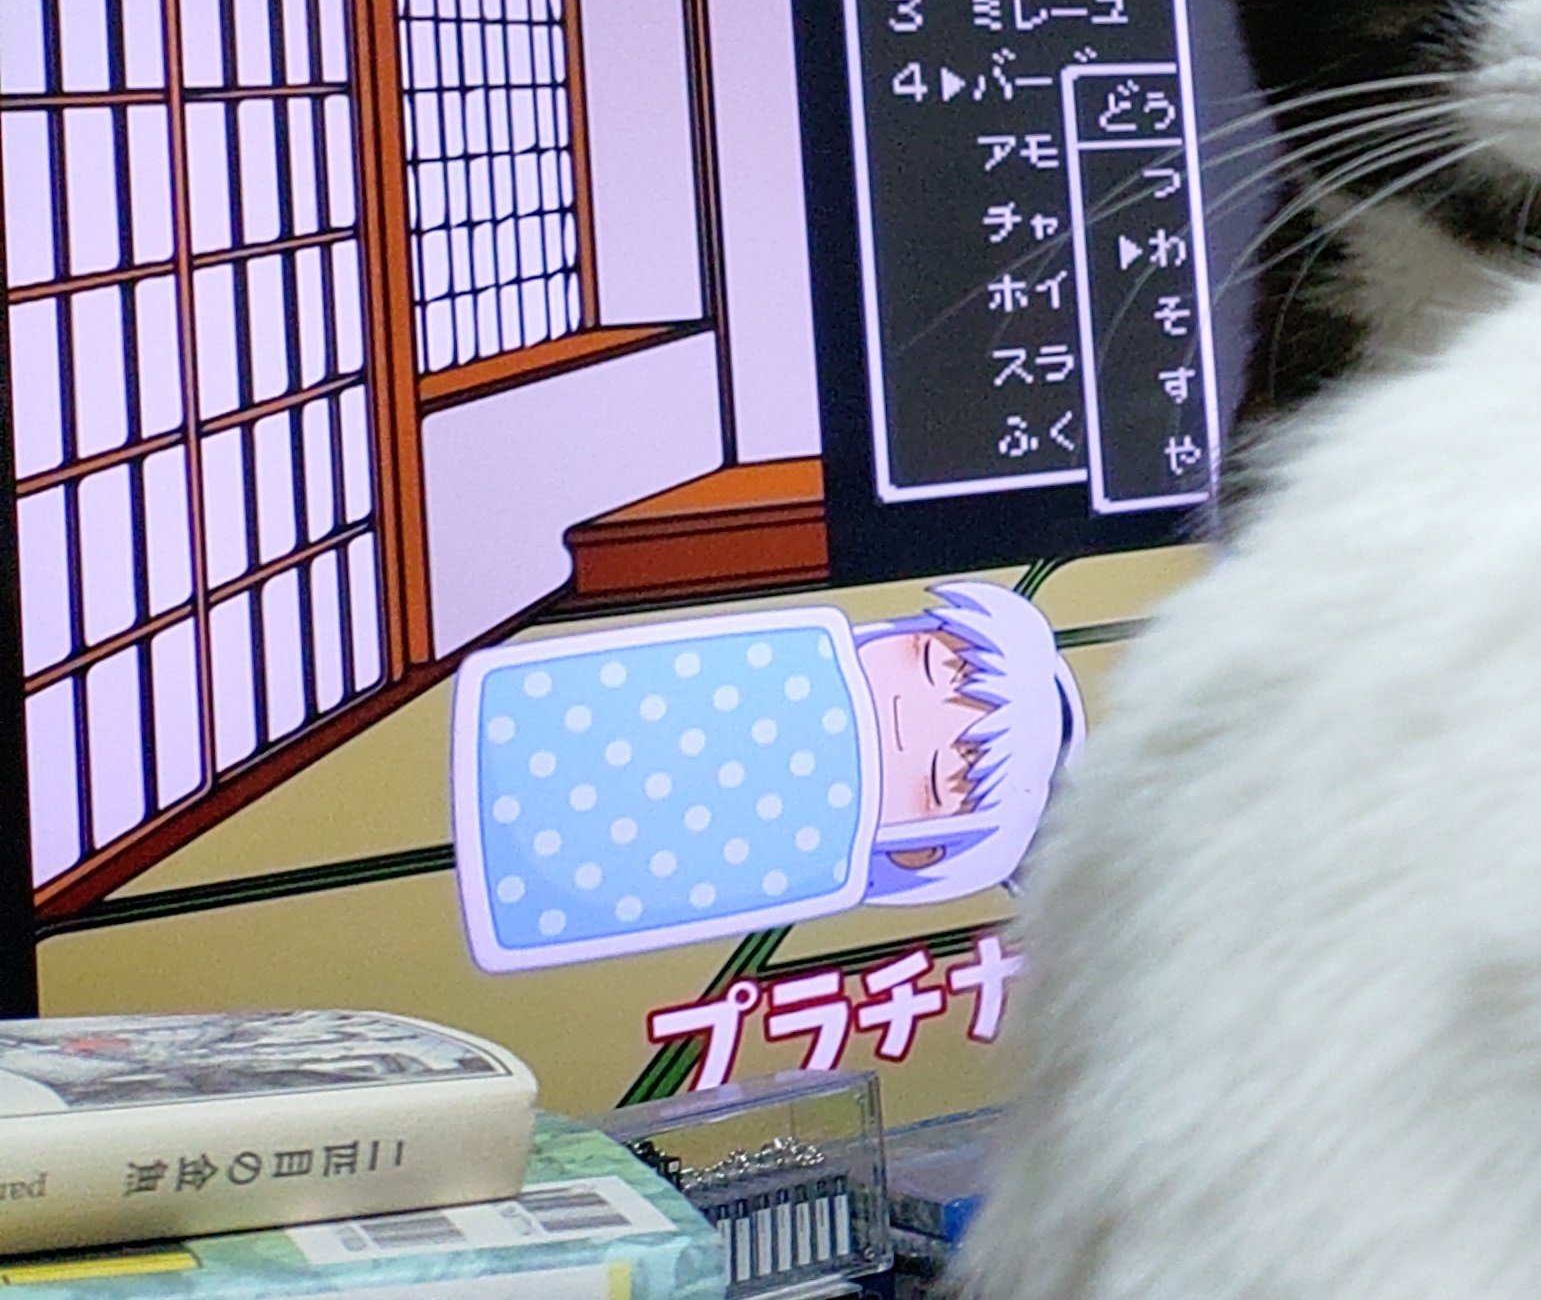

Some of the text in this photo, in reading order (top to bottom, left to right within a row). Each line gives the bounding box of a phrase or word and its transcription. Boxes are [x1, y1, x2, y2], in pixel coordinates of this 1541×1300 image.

[892, 47, 1097, 102] 4 バー
[1099, 79, 1176, 132] どう
[977, 134, 1060, 171] アモ
[1141, 168, 1181, 198] つ
[983, 202, 1059, 243] チャ
[1148, 228, 1187, 269] わ
[988, 271, 1069, 313] ホイ
[1154, 296, 1191, 336] そ
[993, 345, 1075, 386] スラ
[1158, 366, 1196, 405] す
[999, 411, 1075, 456] ふく
[1164, 435, 1202, 475] や
[124, 1139, 405, 1197] 二匹目の金魚
